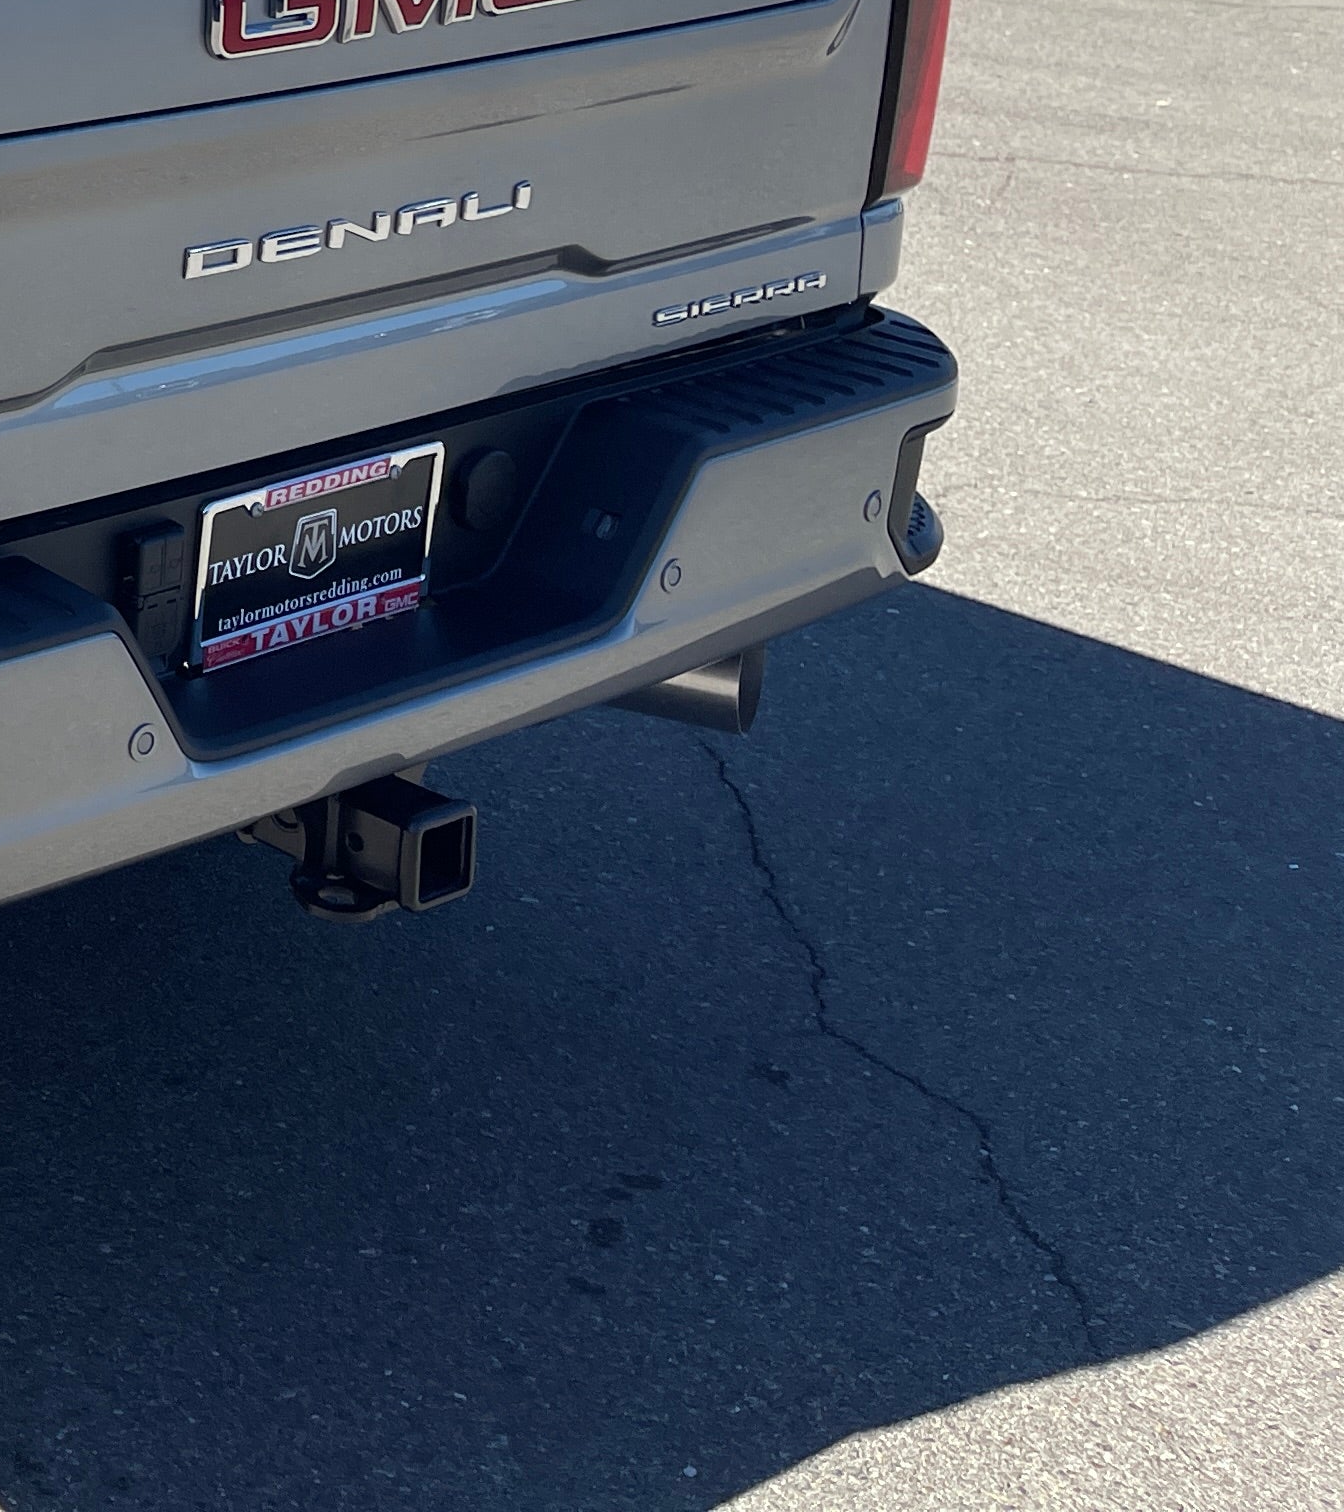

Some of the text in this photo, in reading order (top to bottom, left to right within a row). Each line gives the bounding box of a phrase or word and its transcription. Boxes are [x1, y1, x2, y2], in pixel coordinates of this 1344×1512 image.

[183, 180, 532, 279] DENALI
[652, 271, 828, 327] SIERRA
[269, 461, 389, 506] REDDING
[209, 544, 287, 586] TAYLOR
[338, 506, 423, 548] MOTORS
[218, 567, 402, 632] taylormotorsredding.com
[252, 596, 378, 651] TAYLOR
[385, 591, 419, 612] GMC
